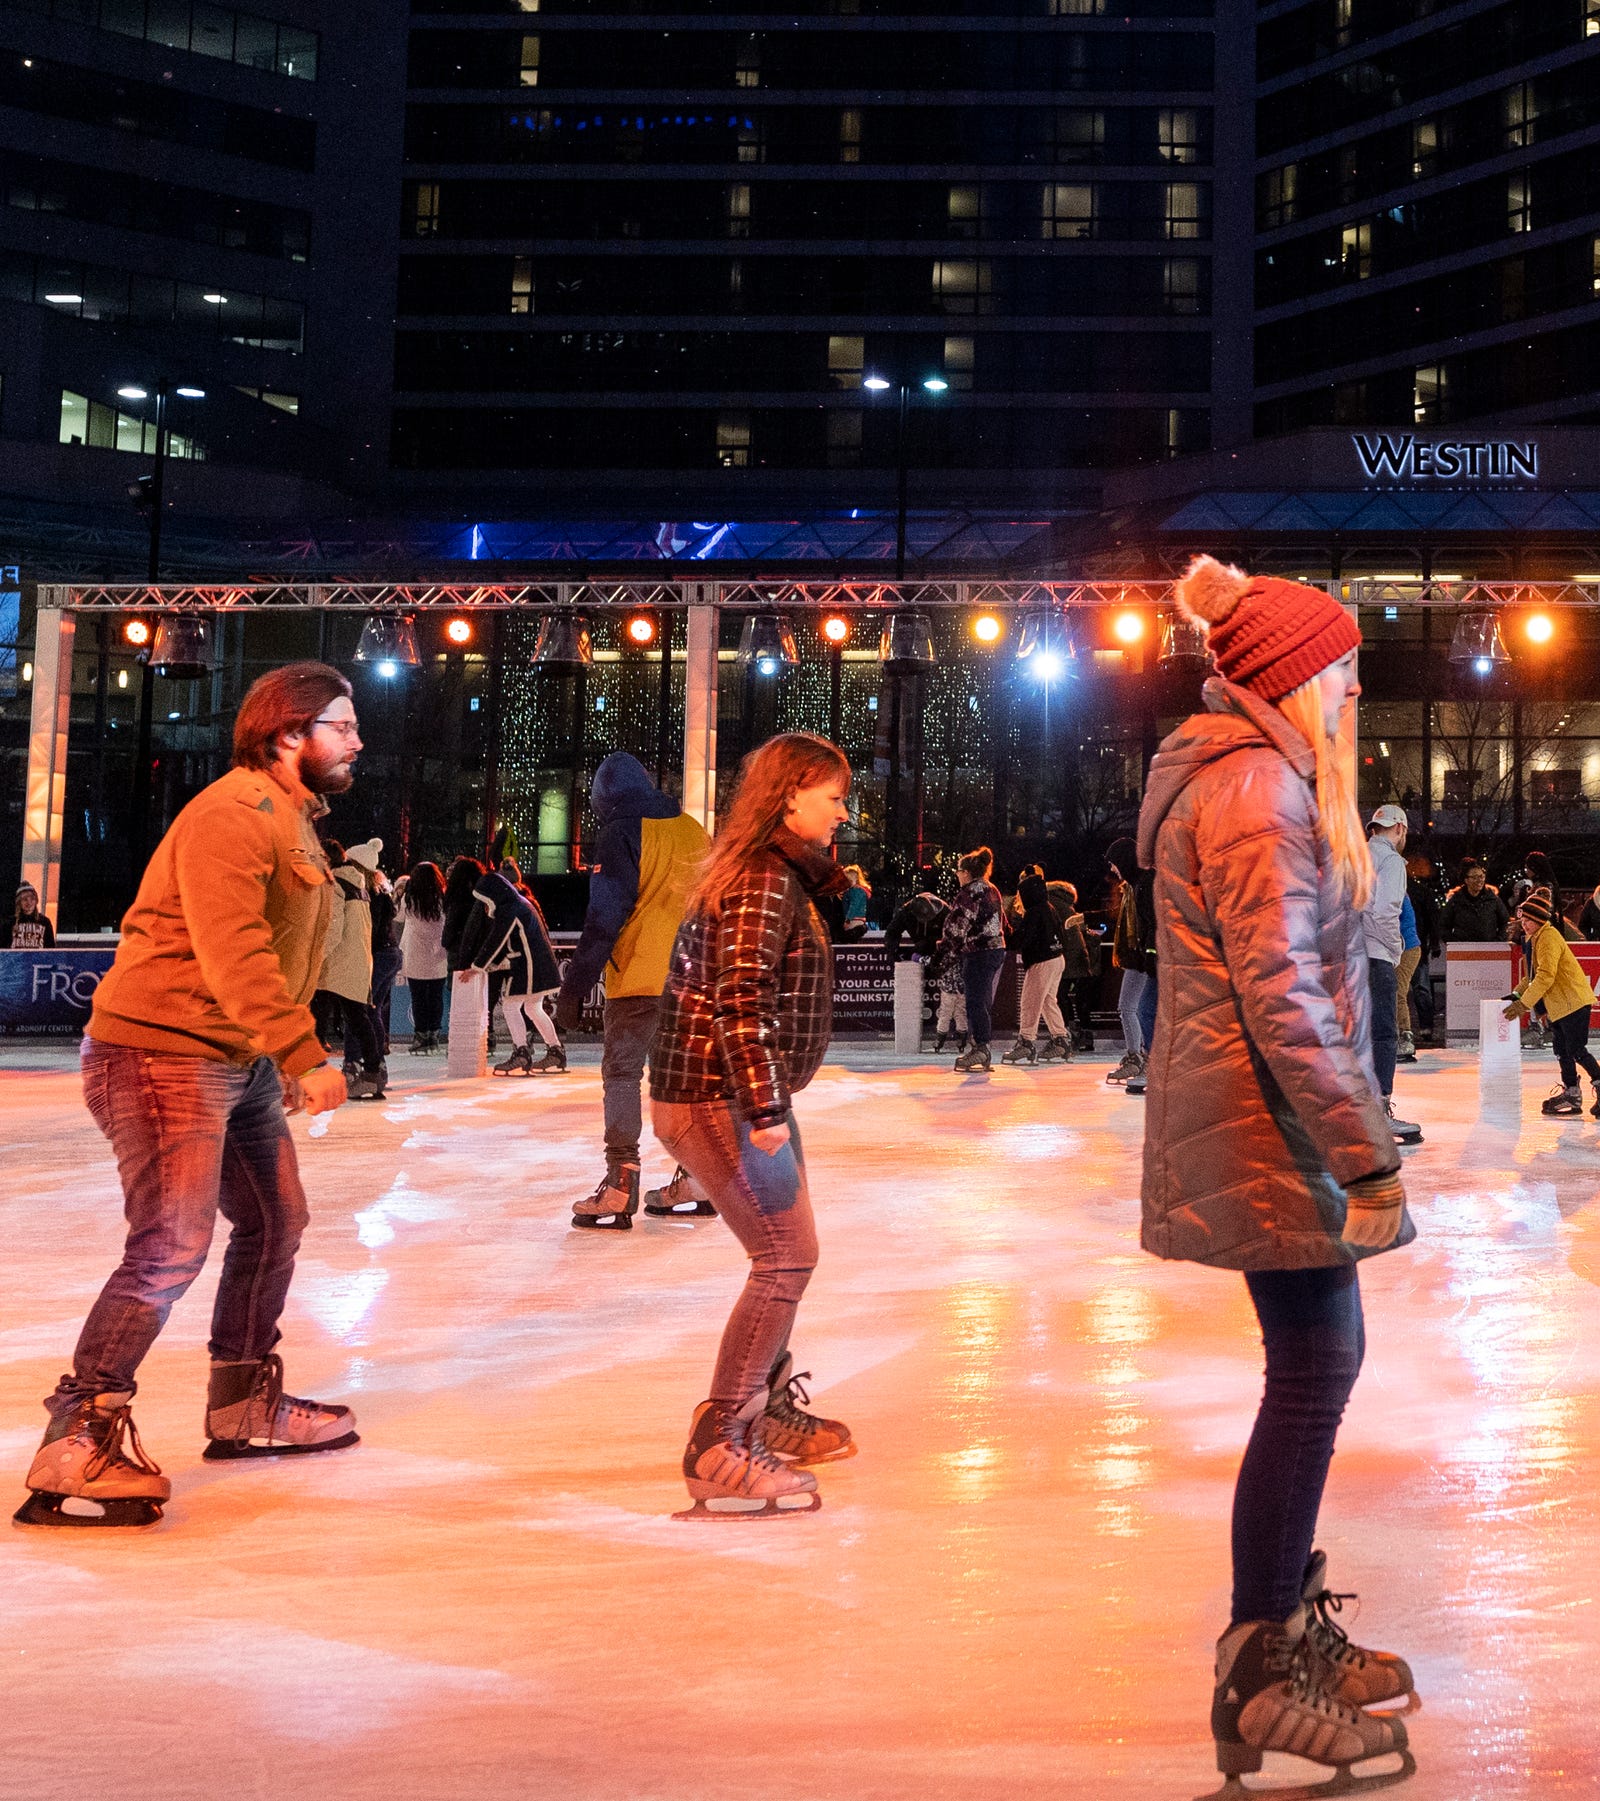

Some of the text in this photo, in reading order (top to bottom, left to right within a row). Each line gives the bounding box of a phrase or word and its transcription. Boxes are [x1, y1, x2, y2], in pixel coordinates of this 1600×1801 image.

[1352, 434, 1538, 478] WESTIN
[32, 964, 108, 1009] FRO
[839, 979, 870, 988] YOUR
